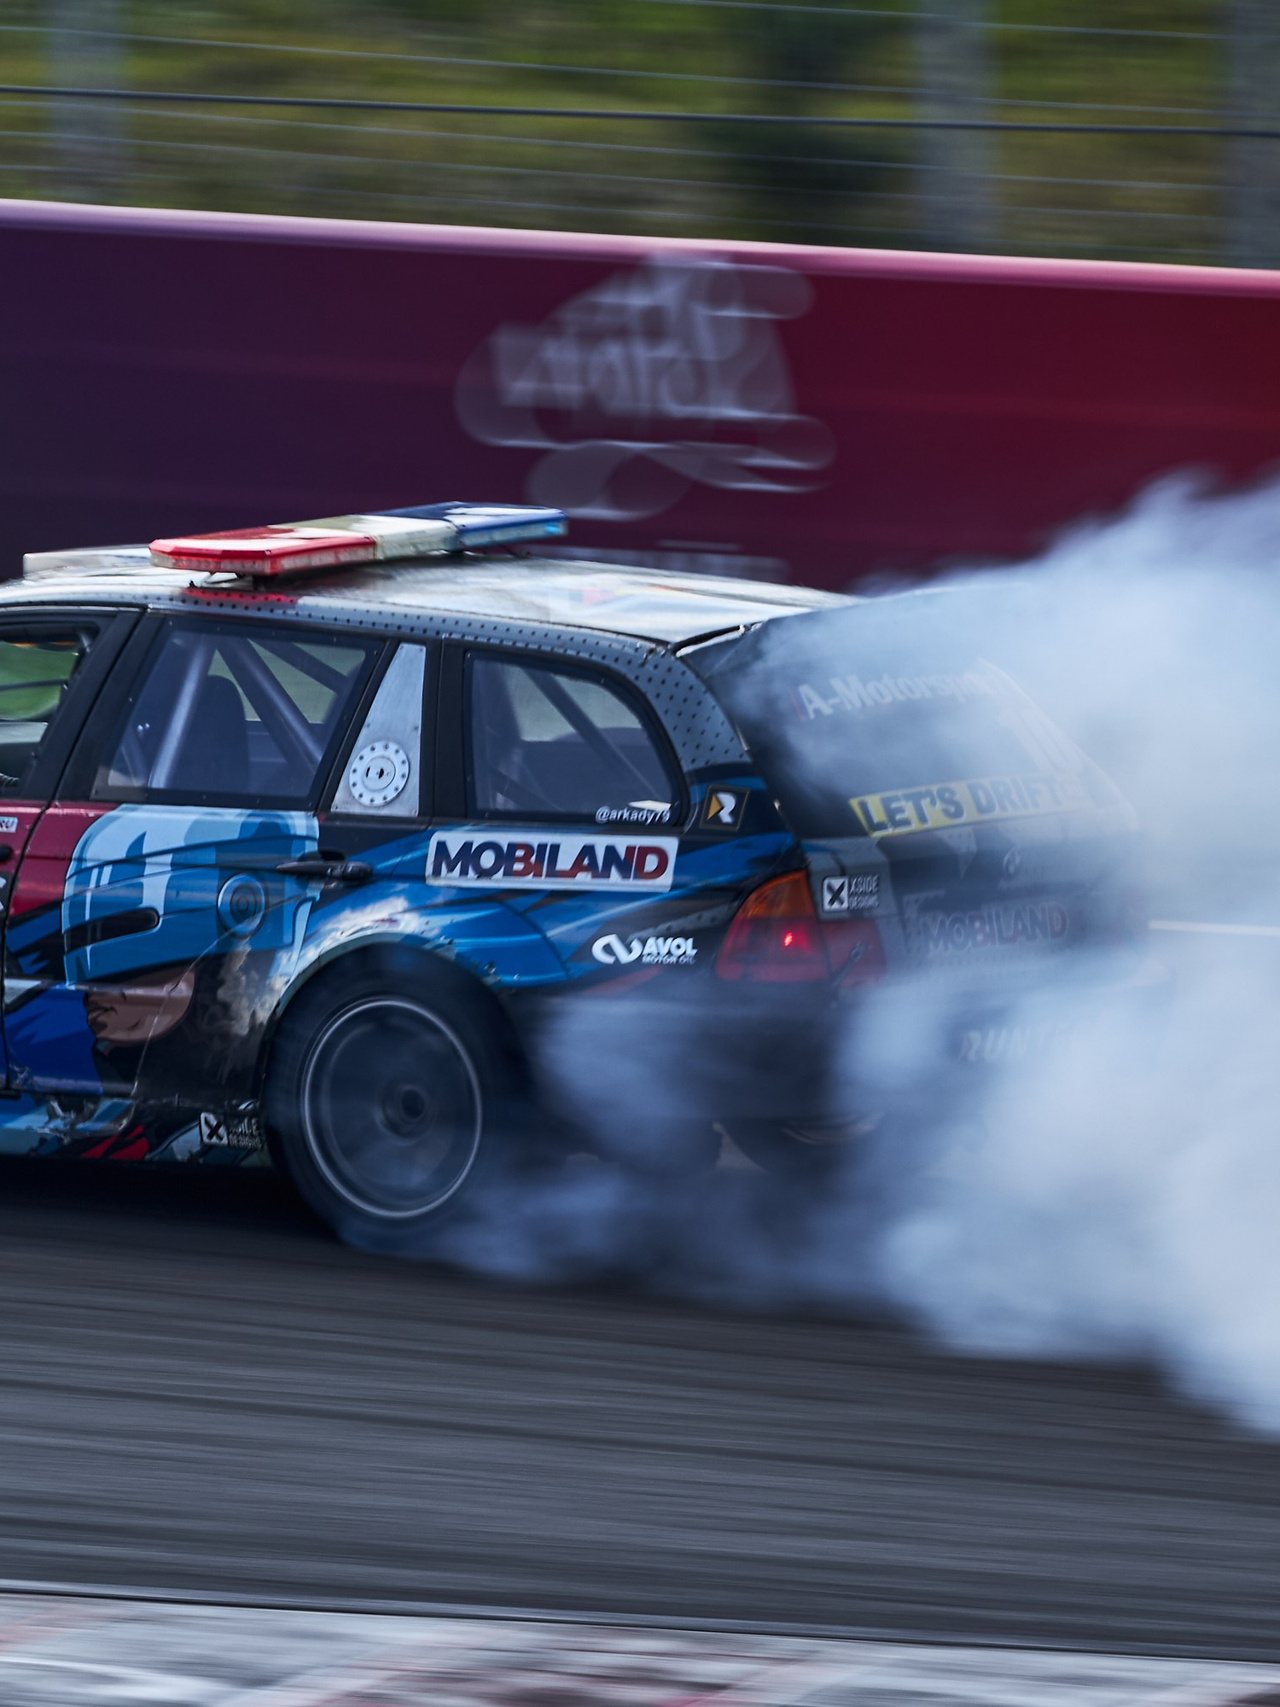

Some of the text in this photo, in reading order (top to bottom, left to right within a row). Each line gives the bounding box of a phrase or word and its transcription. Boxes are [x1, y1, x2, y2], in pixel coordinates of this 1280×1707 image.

[861, 787, 965, 833] LET'S
[431, 840, 669, 881] MOBILAND
[642, 936, 698, 957] AVOL
[921, 903, 1070, 957] MOBILAND
